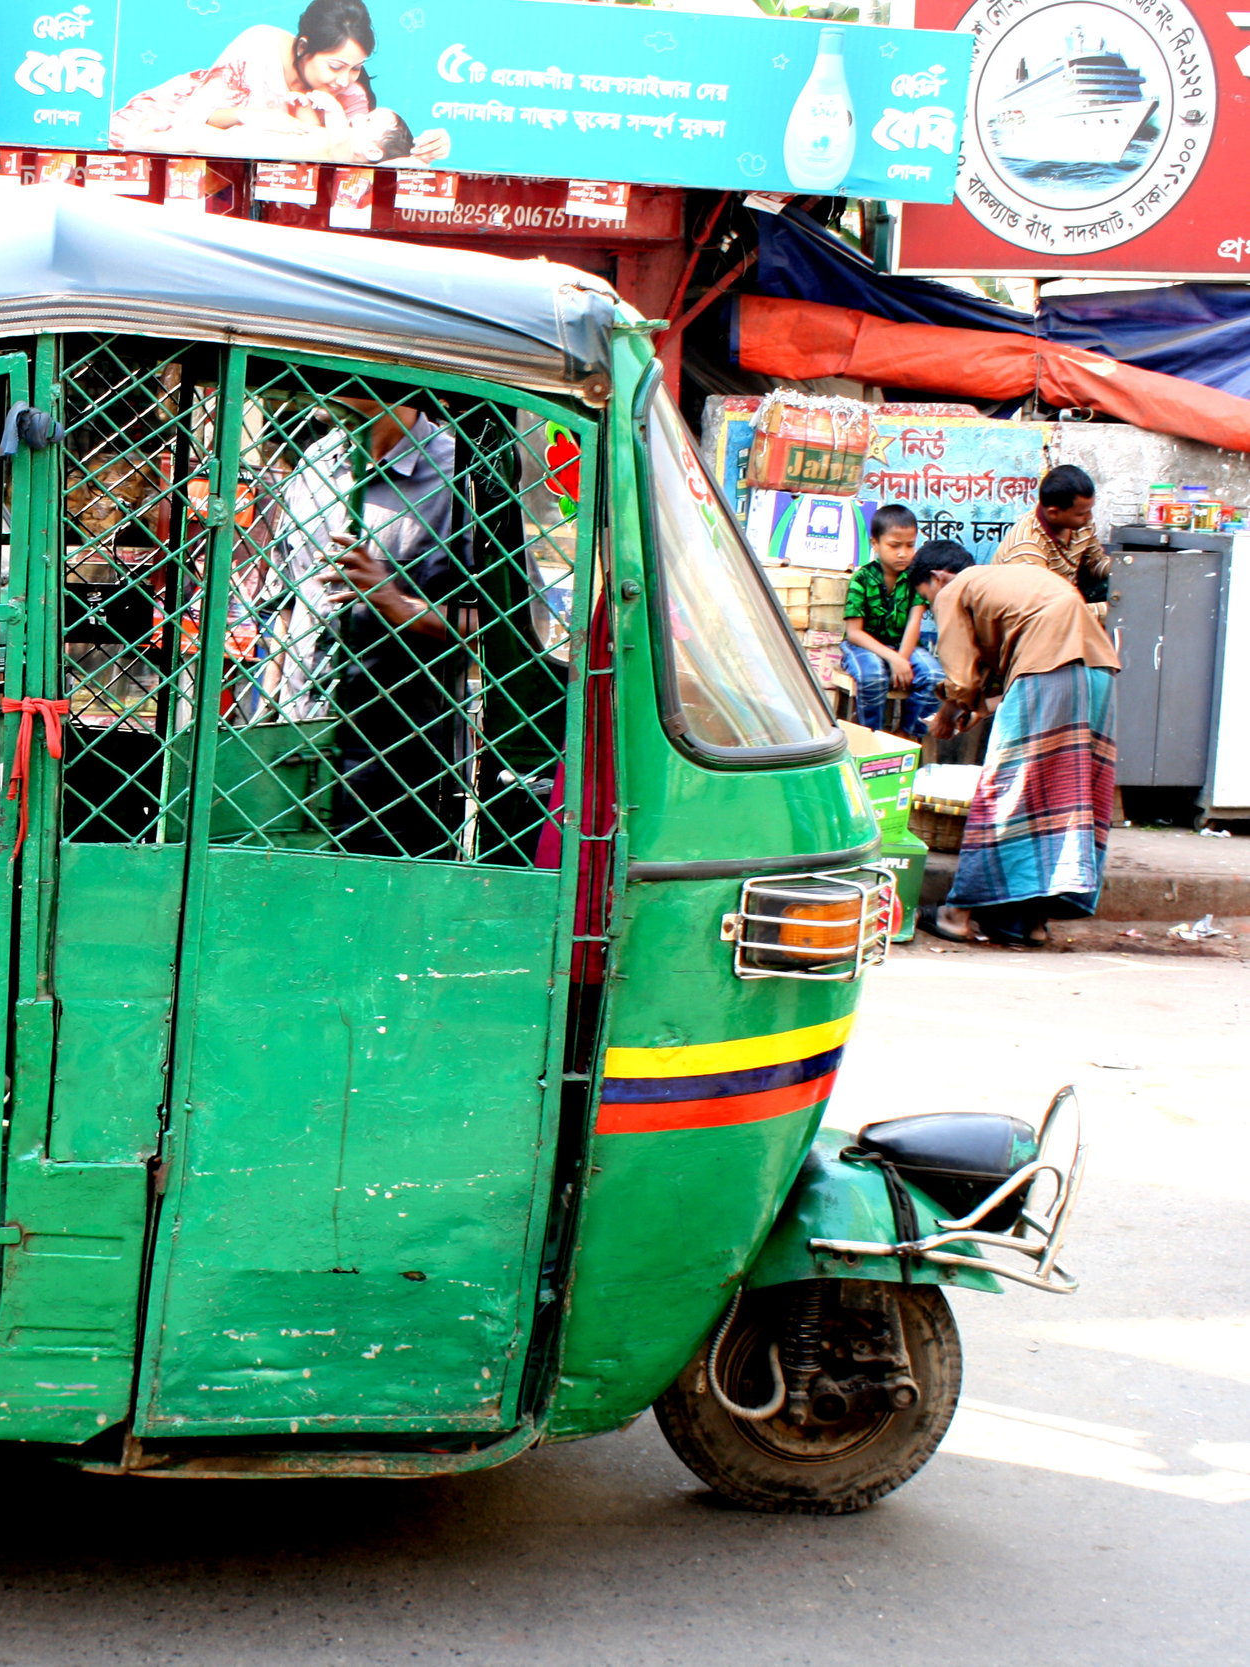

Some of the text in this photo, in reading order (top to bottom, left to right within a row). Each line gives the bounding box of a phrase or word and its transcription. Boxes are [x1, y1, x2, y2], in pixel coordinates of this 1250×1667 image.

[14, 48, 107, 99] বেবি
[696, 84, 730, 102] দেয়
[33, 108, 81, 127] লোশন
[519, 107, 568, 130] নাজুক
[572, 111, 623, 133] ত্বকের
[626, 113, 678, 139] সম্পূর্ণ
[871, 106, 957, 155] বেবি
[901, 428, 948, 460] নিউ
[863, 469, 922, 500] পদ্মা
[997, 475, 1038, 504] কোং
